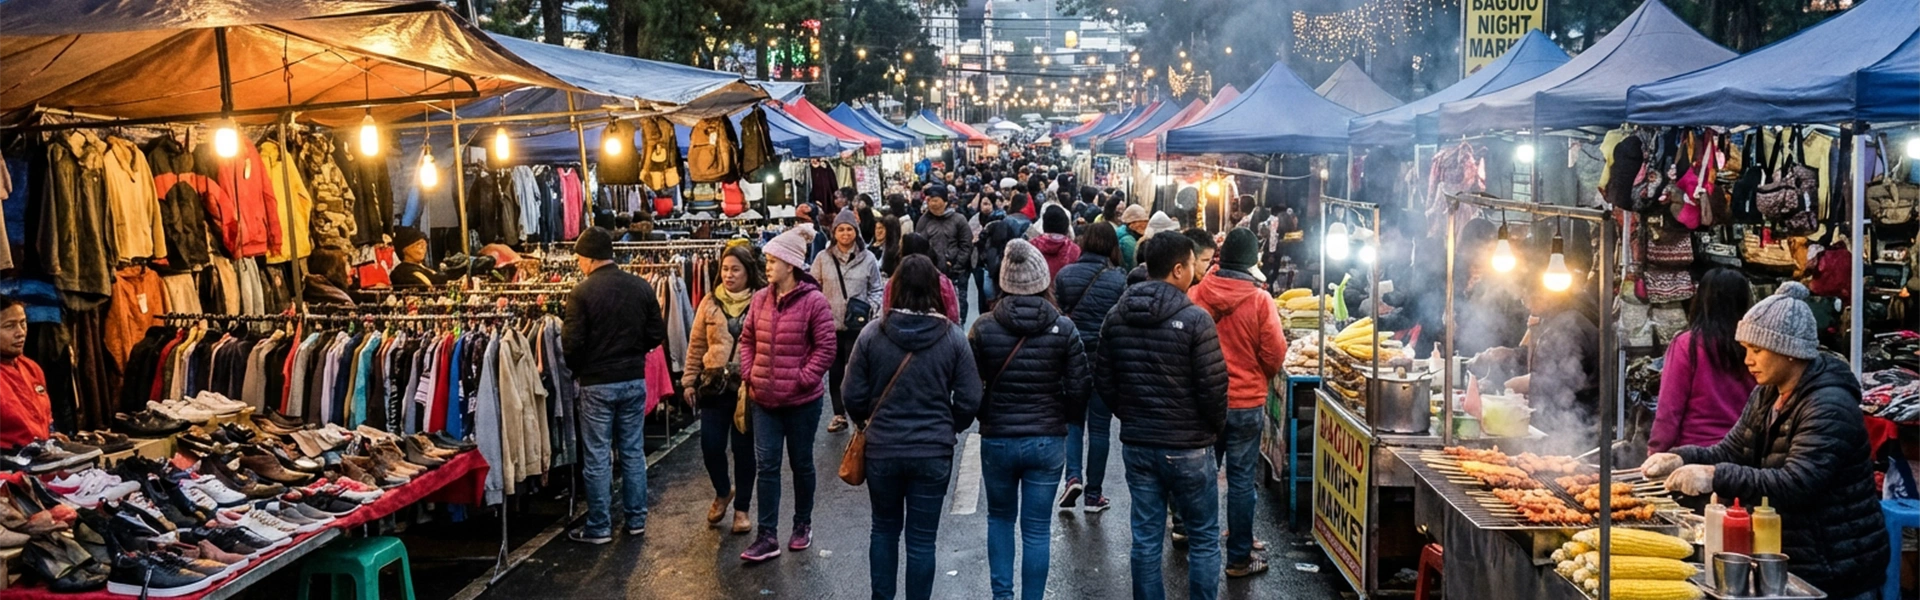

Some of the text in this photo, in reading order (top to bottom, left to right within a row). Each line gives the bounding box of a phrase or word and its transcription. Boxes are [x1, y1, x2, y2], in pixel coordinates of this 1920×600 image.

[1478, 15, 1532, 34] NIGHT
[1320, 409, 1365, 474] BAGUIO
[1323, 448, 1359, 510] NIGHT
[1317, 480, 1364, 557] MARKET
